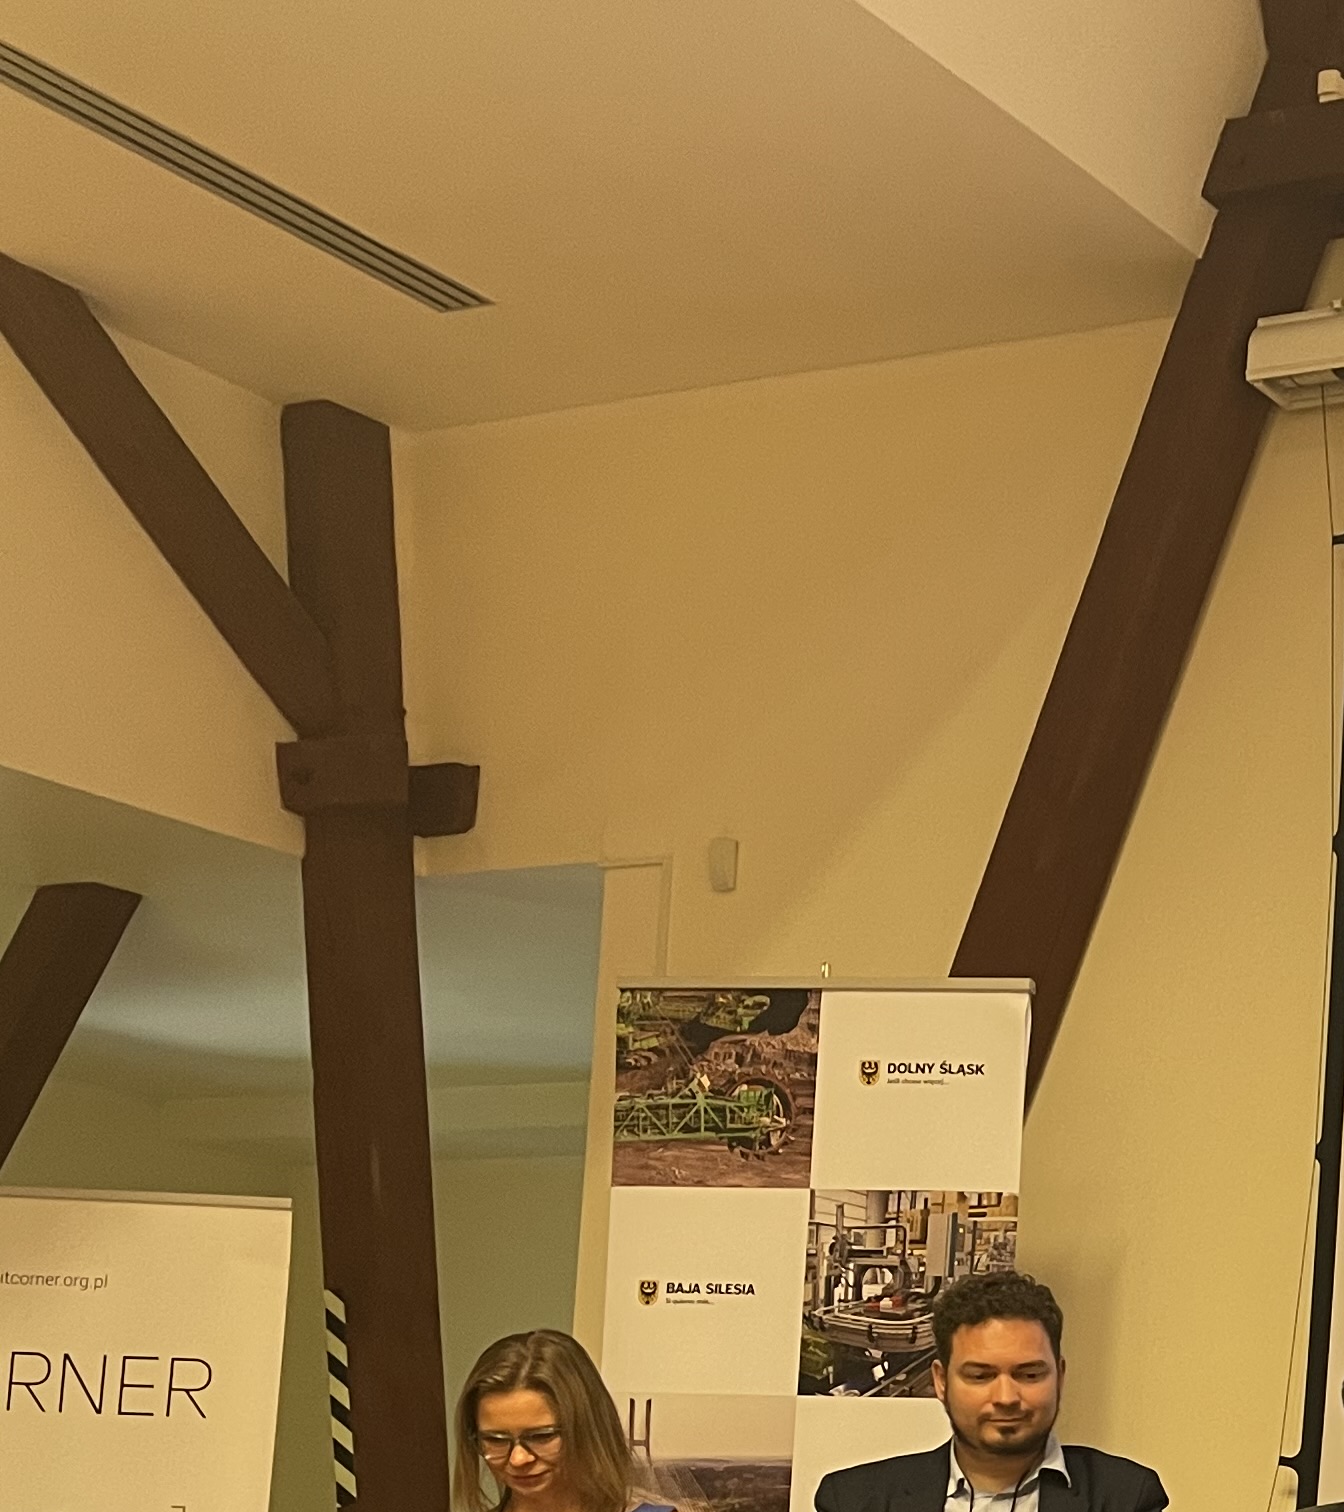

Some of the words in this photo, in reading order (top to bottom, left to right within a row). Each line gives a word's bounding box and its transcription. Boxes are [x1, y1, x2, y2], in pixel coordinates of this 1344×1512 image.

[888, 1062, 935, 1074] DOLNY
[940, 1060, 985, 1076] ŚLĄSK
[666, 1282, 701, 1294] BAJA
[705, 1283, 755, 1295] SILESIA
